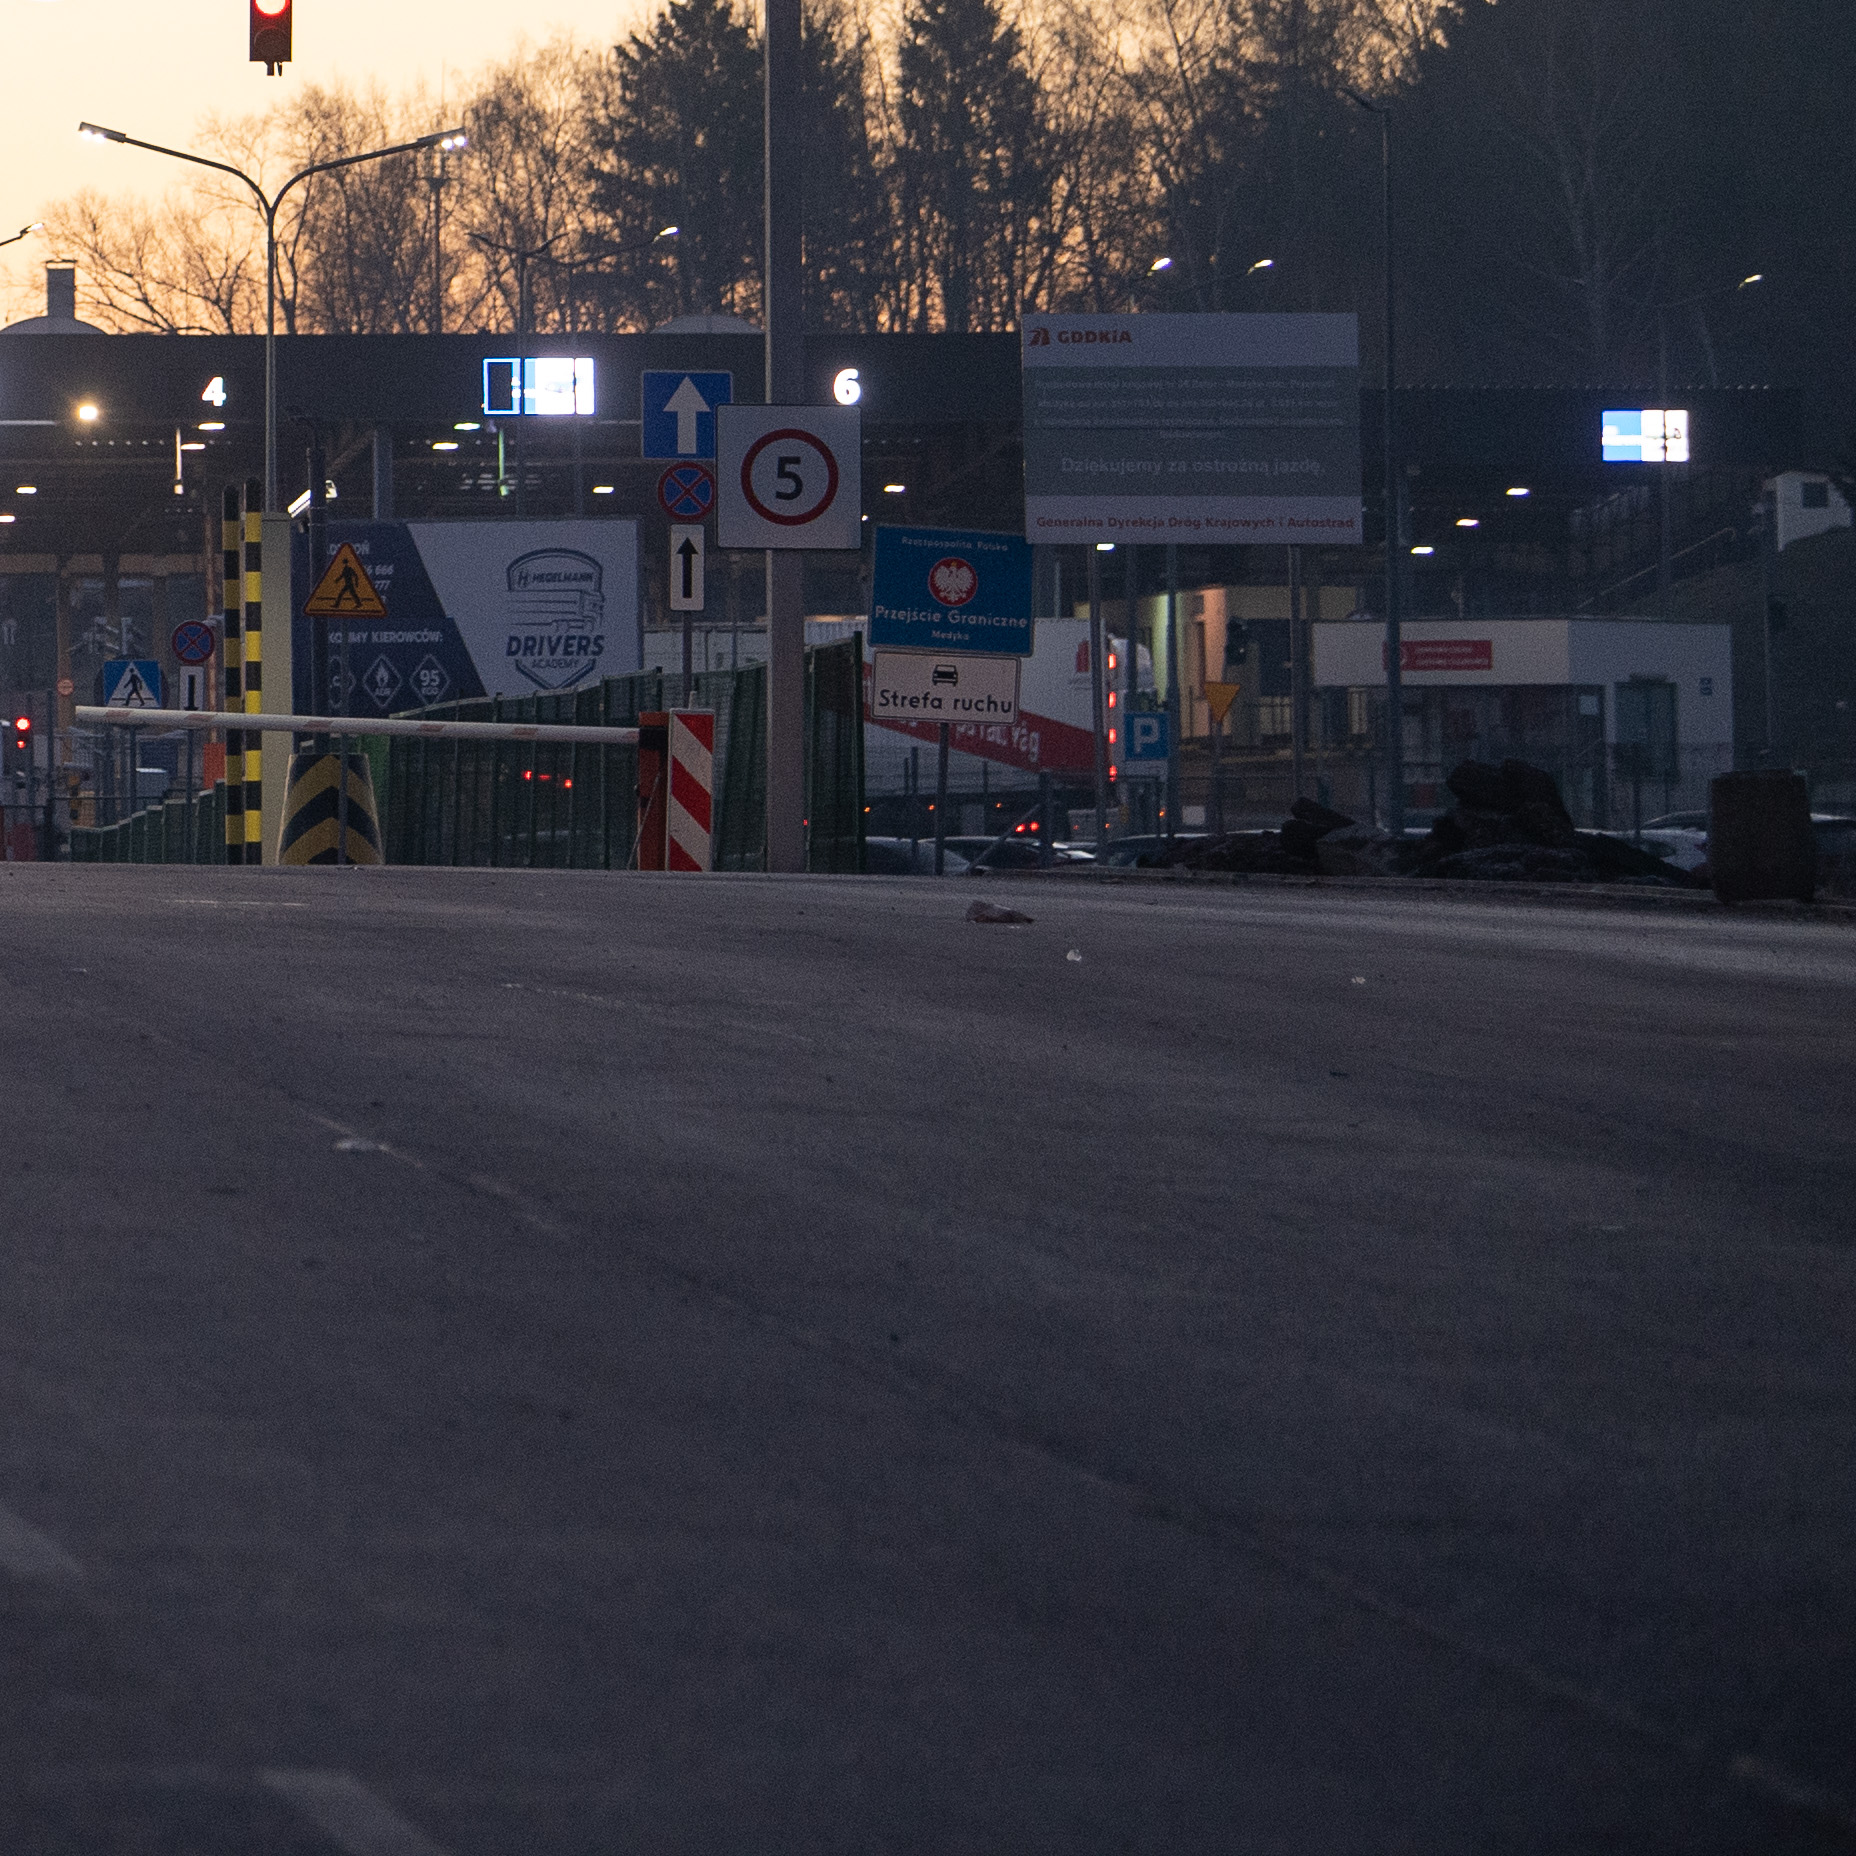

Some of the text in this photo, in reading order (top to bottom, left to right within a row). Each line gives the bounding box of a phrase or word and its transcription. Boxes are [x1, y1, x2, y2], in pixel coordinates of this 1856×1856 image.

[1057, 328, 1132, 345] GDDKiA
[201, 376, 227, 407] 4
[833, 367, 862, 405] 6
[775, 455, 803, 501] 5
[1061, 457, 1163, 476] Dziękujemy
[1168, 460, 1186, 473] za
[1036, 517, 1103, 528] Generalna
[1108, 517, 1165, 531] Dyrekcja
[1169, 516, 1201, 531] Dróg
[1205, 517, 1275, 531] Krajowych
[1287, 516, 1354, 528] Autostrad
[874, 604, 1028, 628] Przejście Graniczne
[506, 635, 605, 657] DRIVERS
[531, 658, 580, 669] ACADEMY
[419, 669, 440, 686] 95
[878, 689, 1012, 713] Strefa ruchu
[1133, 717, 1159, 754] P
